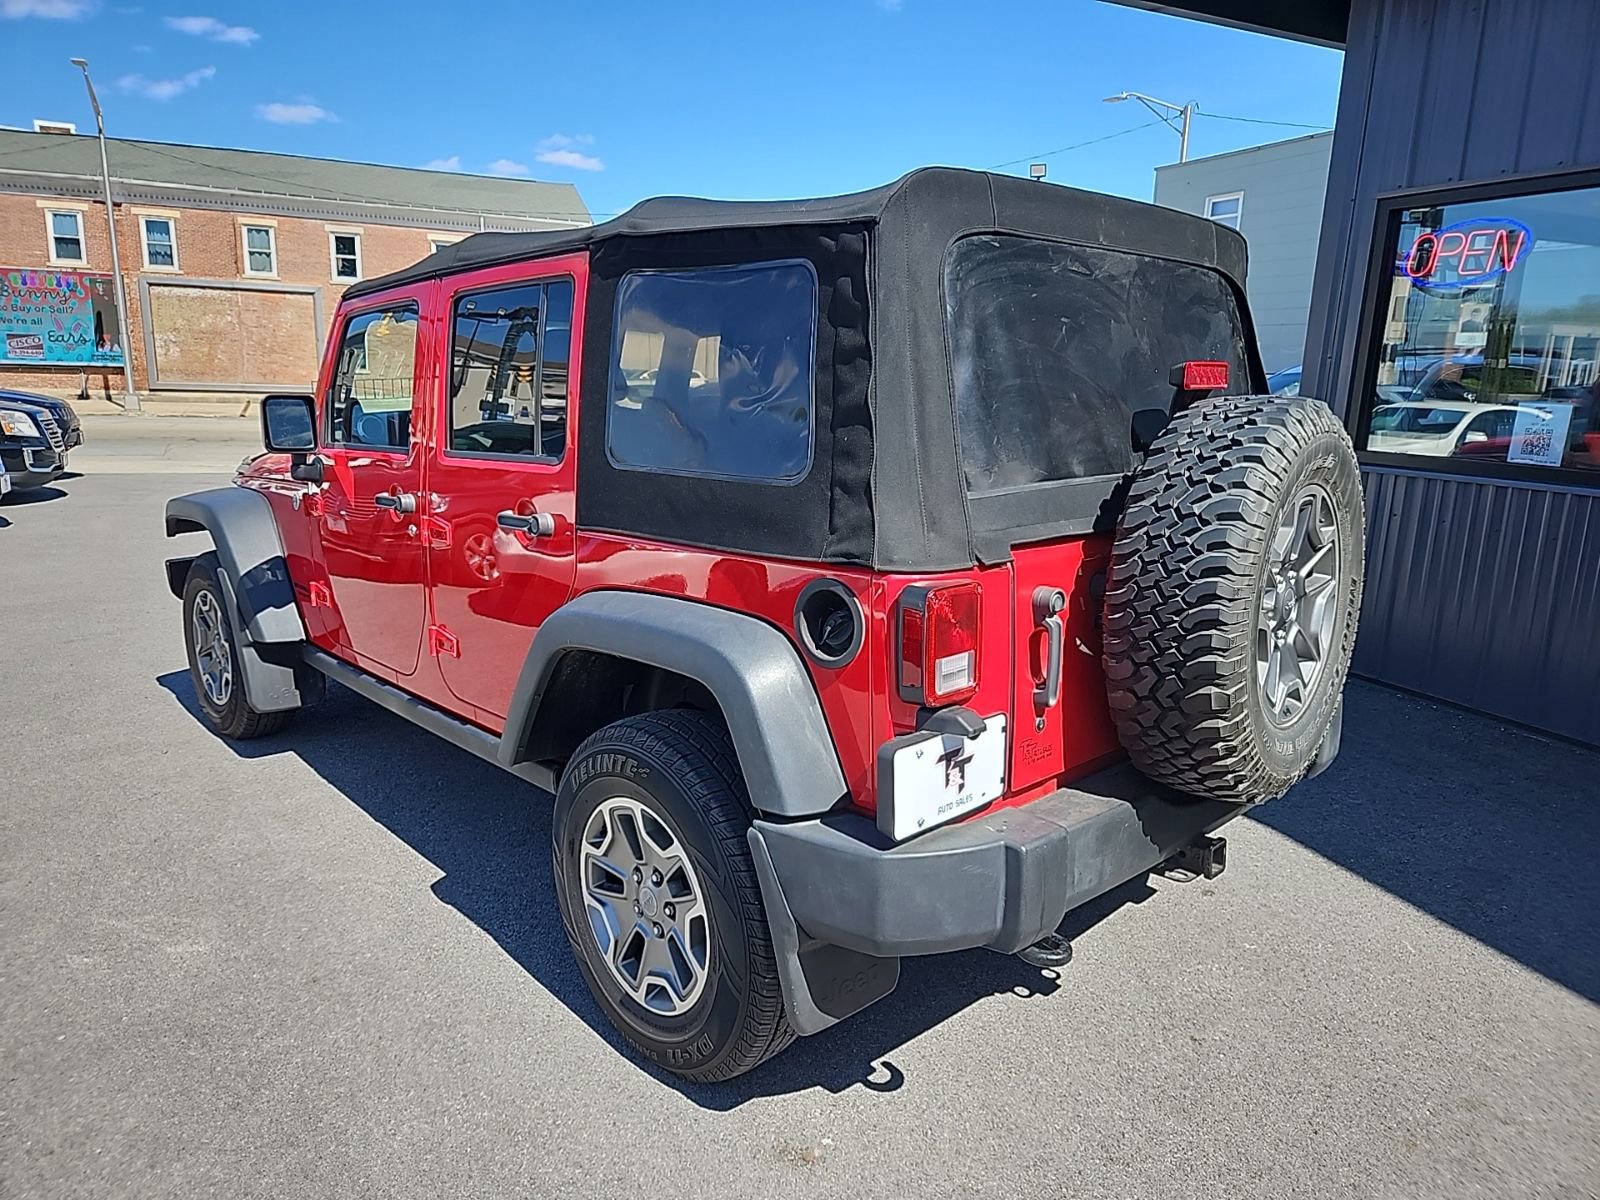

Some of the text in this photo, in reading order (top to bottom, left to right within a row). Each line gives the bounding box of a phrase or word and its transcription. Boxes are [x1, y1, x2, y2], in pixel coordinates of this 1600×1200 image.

[1407, 229, 1525, 277] OPEN
[0, 283, 72, 305] Bunny
[11, 303, 31, 313] Buy
[48, 304, 74, 314] Sell?
[30, 317, 43, 325] all
[8, 336, 41, 348] CISCO
[47, 330, 91, 345] Ears
[570, 753, 638, 792] DELINTE
[937, 793, 974, 816] AUTO SALES
[666, 1032, 714, 1065] DX-11
